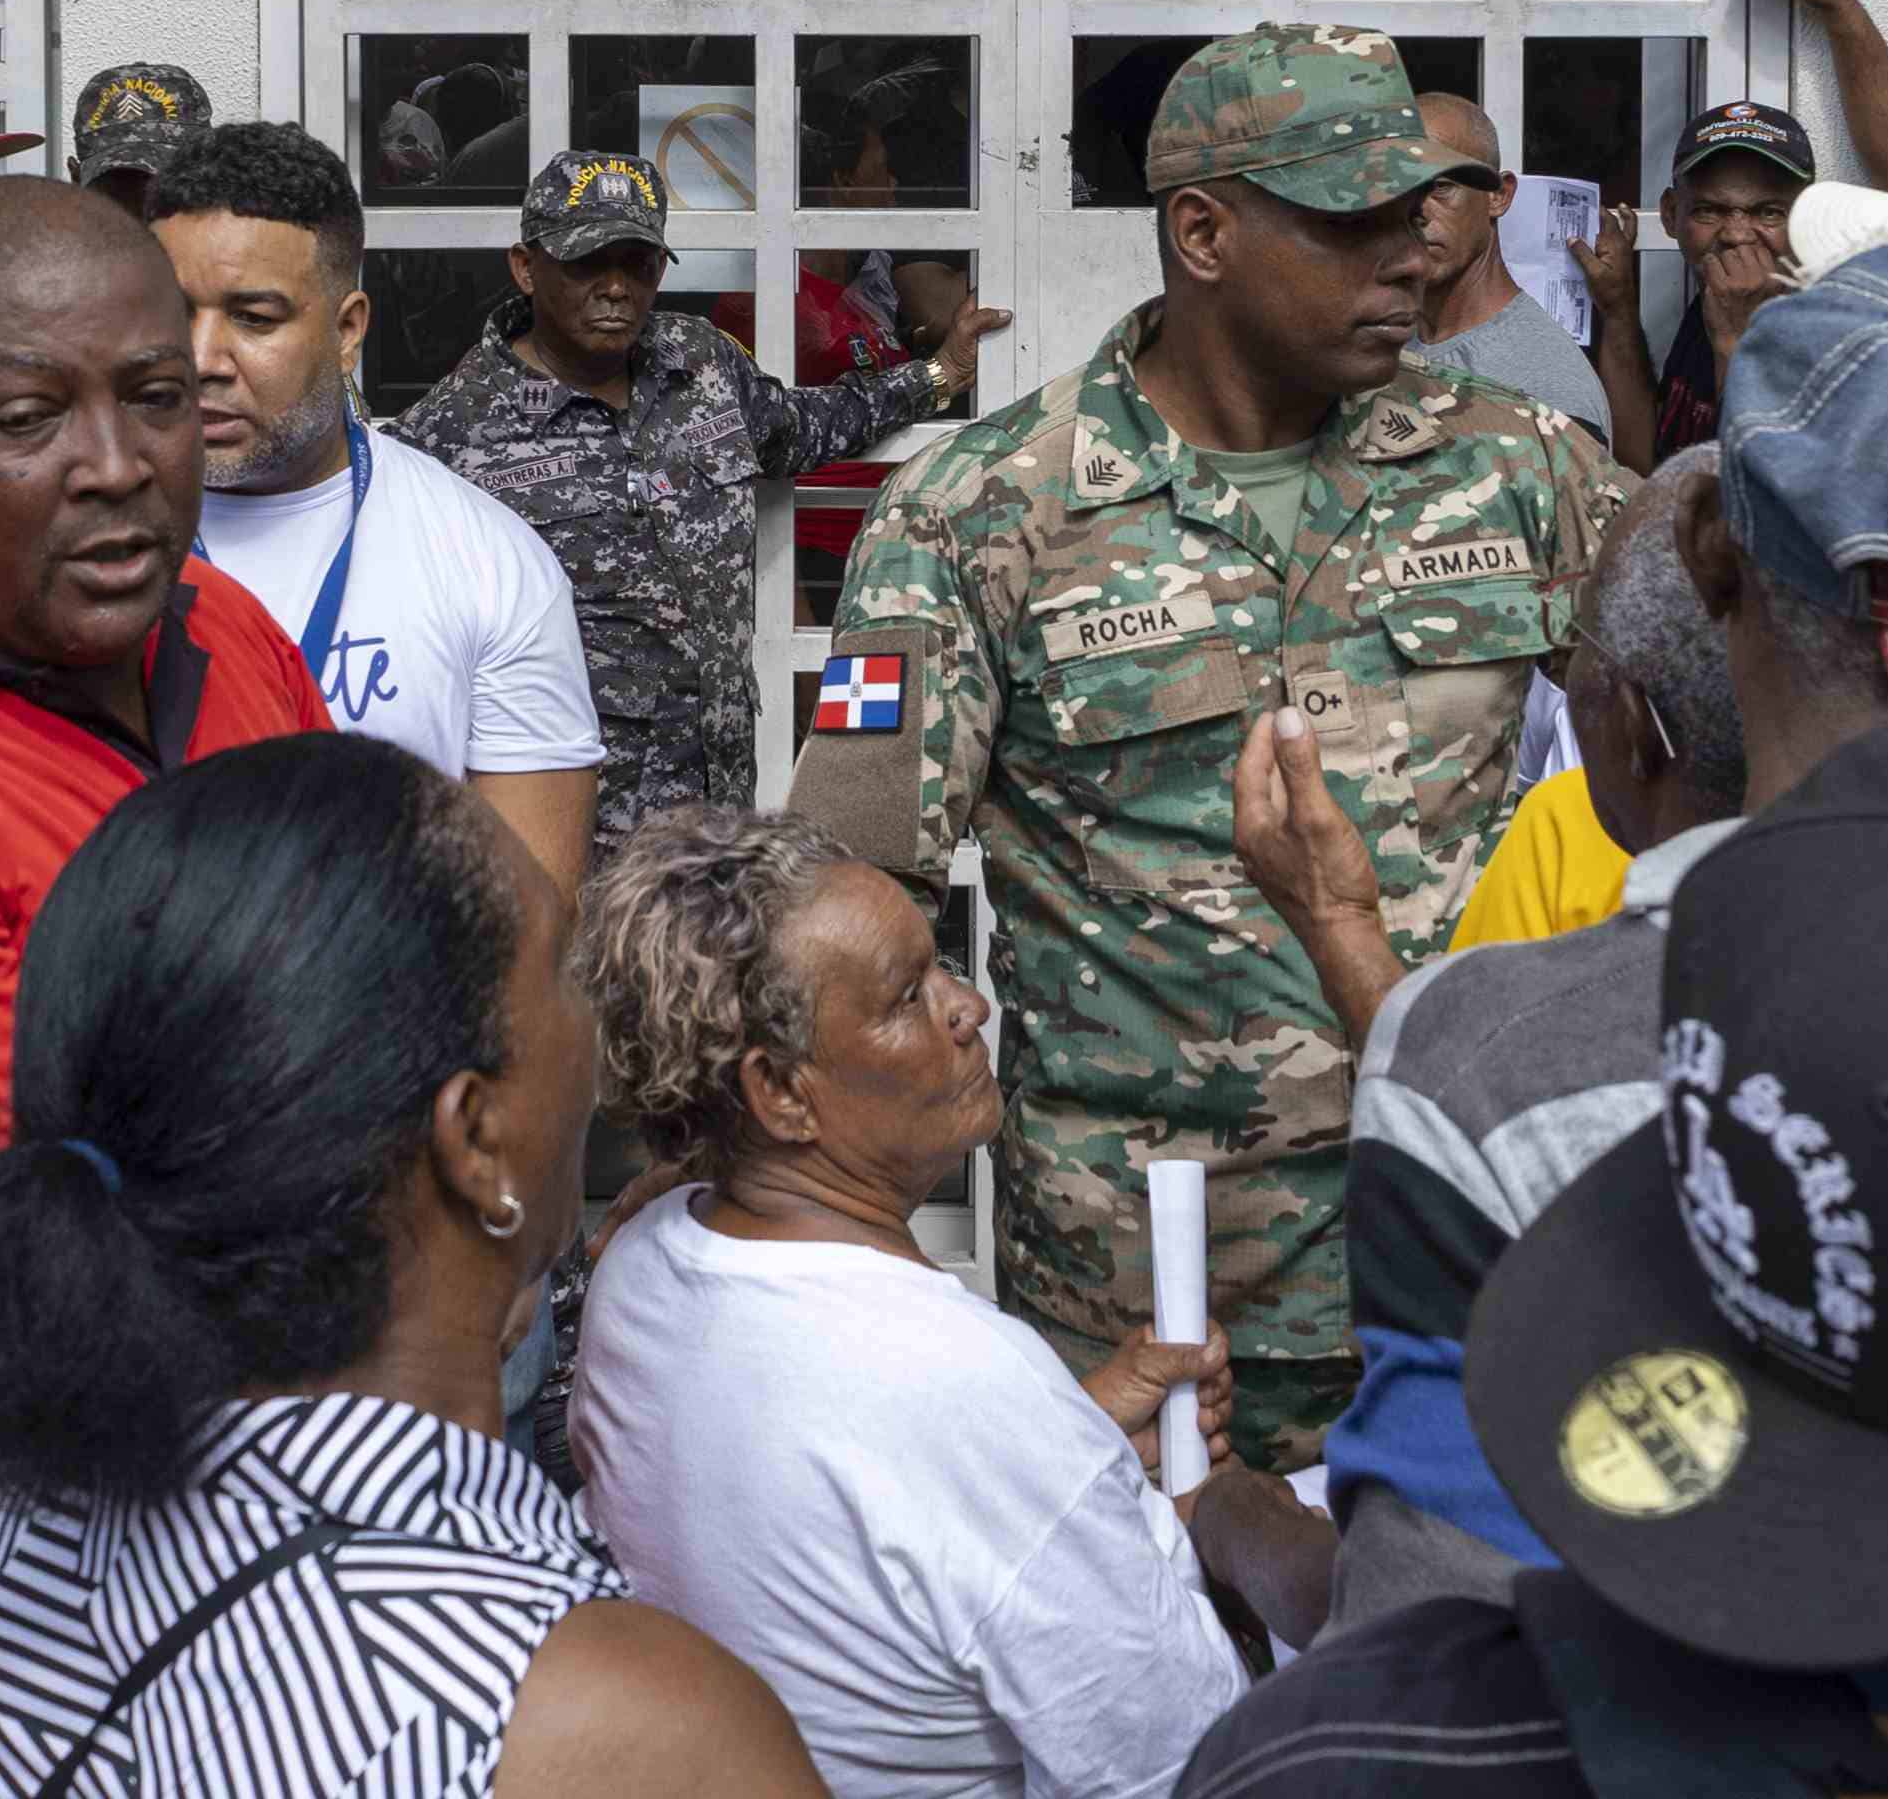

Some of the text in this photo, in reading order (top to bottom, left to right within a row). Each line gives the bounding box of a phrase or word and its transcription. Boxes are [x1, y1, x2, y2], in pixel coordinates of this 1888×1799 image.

[484, 464, 551, 490] CONTRERAS
[1401, 545, 1518, 581] ARMADA
[1080, 606, 1177, 648] ROCHA
